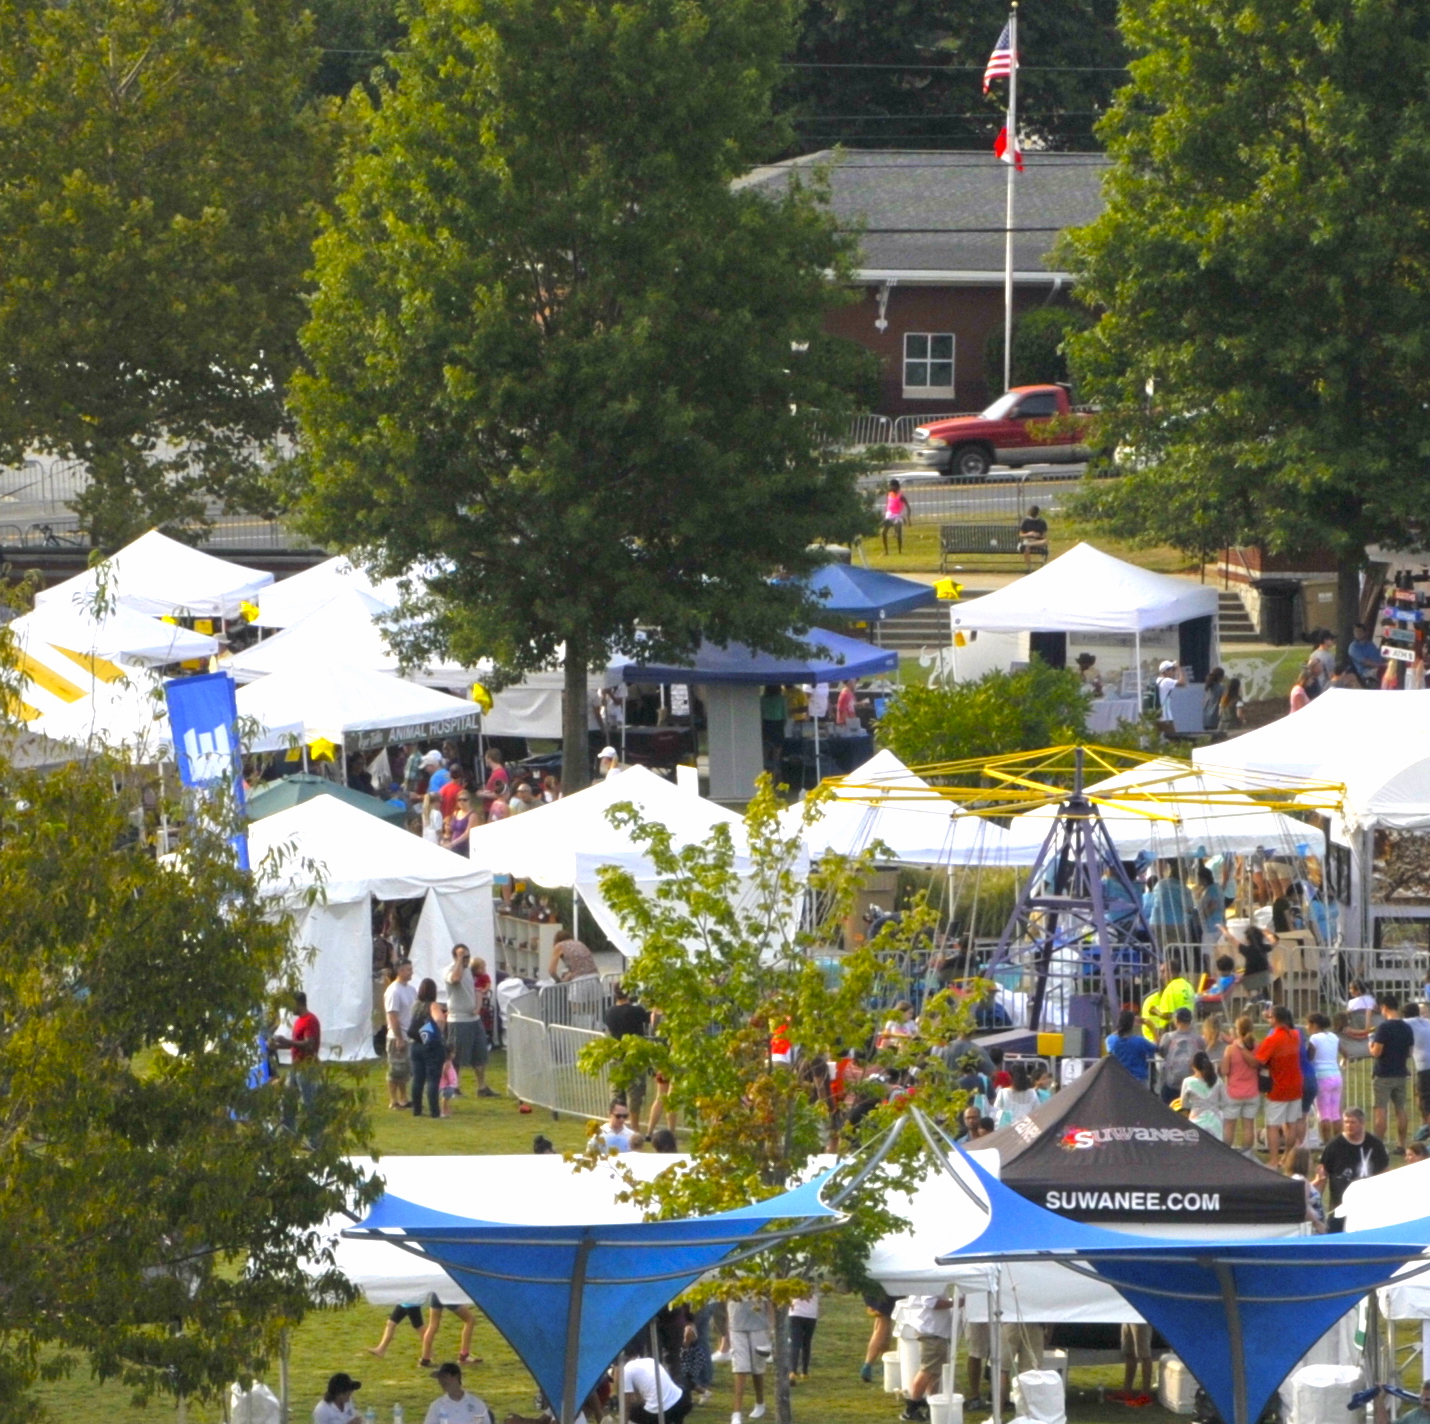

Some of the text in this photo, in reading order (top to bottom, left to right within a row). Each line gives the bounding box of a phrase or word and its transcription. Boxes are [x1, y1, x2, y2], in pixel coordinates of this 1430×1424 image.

[389, 725, 427, 742] ANIMAL
[429, 715, 479, 736] HOSPITAL
[1046, 1190, 1220, 1211] SUWANEE.COM
